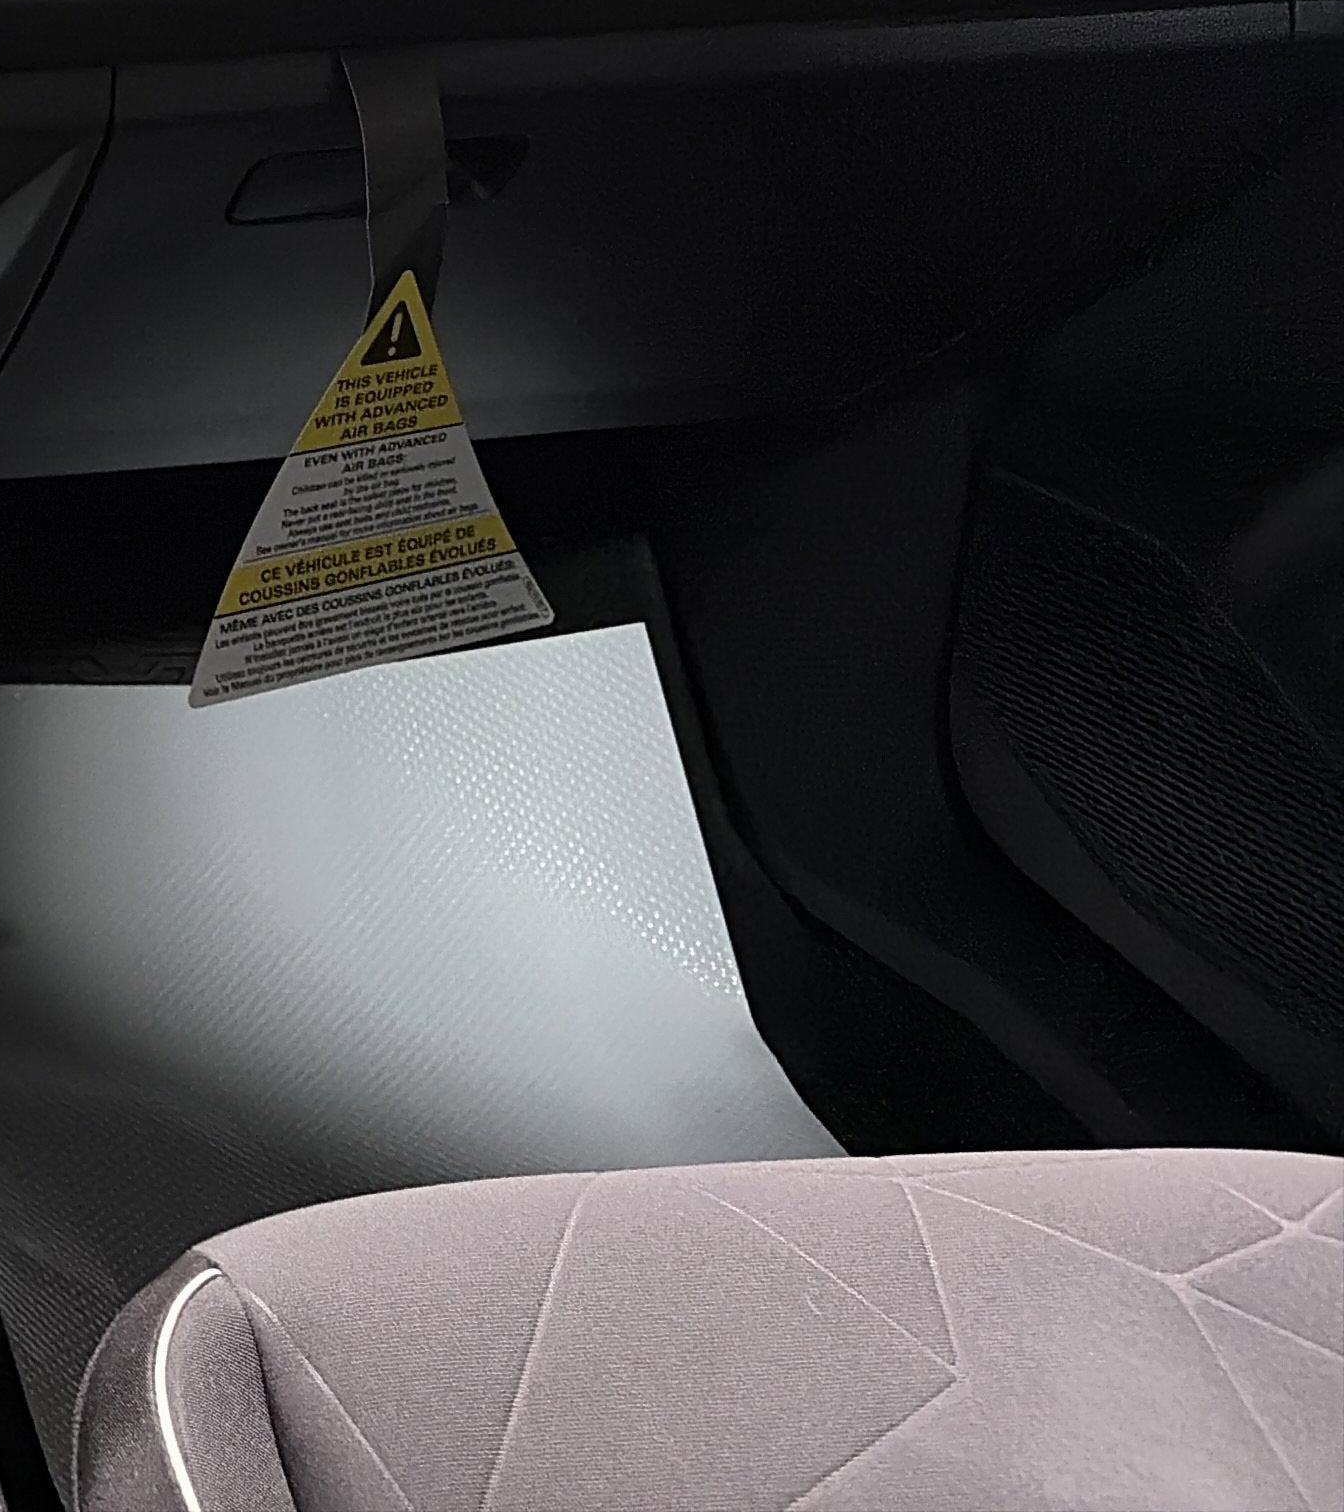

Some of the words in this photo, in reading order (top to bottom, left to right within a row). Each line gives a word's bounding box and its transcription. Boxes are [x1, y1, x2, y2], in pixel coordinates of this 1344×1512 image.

[335, 396, 350, 409] IS
[355, 381, 433, 405] EQUIPPED
[337, 375, 371, 392] THIS
[375, 364, 438, 385] VEHICLE
[314, 411, 356, 429] WITH
[360, 395, 449, 420] ADVANCED
[340, 426, 367, 441] AIR
[373, 416, 418, 434] BAGS
[304, 453, 338, 468] EVEN
[341, 446, 375, 460] WITH
[377, 433, 447, 453] ADVANCED
[342, 461, 364, 473] AIR
[260, 567, 282, 583] CE
[285, 551, 361, 577] VÉHICULE
[365, 542, 392, 560] EST
[397, 528, 451, 553] ÉQUIPÉ
[455, 525, 475, 540] DE
[238, 577, 320, 606] COUSSINS
[324, 553, 425, 586] GONFLABLES
[429, 537, 496, 563] ÉVOLUÉS
[220, 616, 258, 634] MÊME
[262, 608, 294, 625] AVEC
[296, 602, 319, 618] DES
[321, 589, 383, 611] COUSSINS
[384, 571, 460, 597] GONFLABLES
